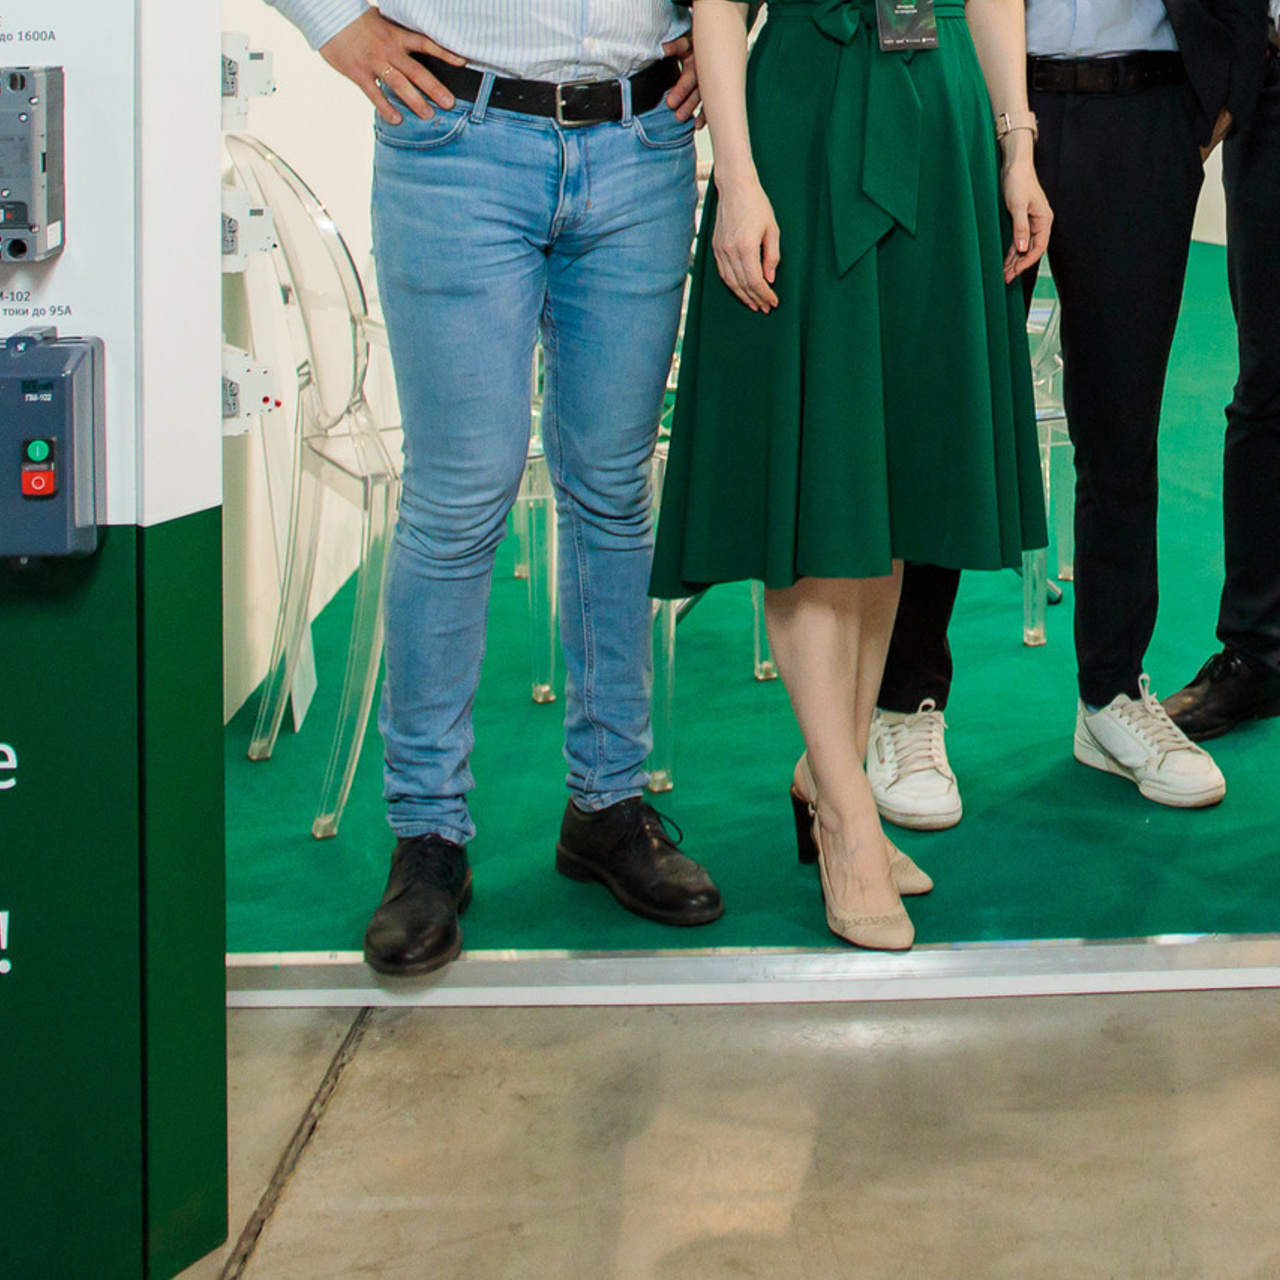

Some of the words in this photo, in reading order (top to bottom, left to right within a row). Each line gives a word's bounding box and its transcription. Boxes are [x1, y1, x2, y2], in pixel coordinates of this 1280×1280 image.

[18, 30, 56, 41] 1600А
[0, 291, 31, 302] -102
[3, 308, 29, 316] токи
[32, 308, 47, 317] до
[49, 305, 72, 317] 95А
